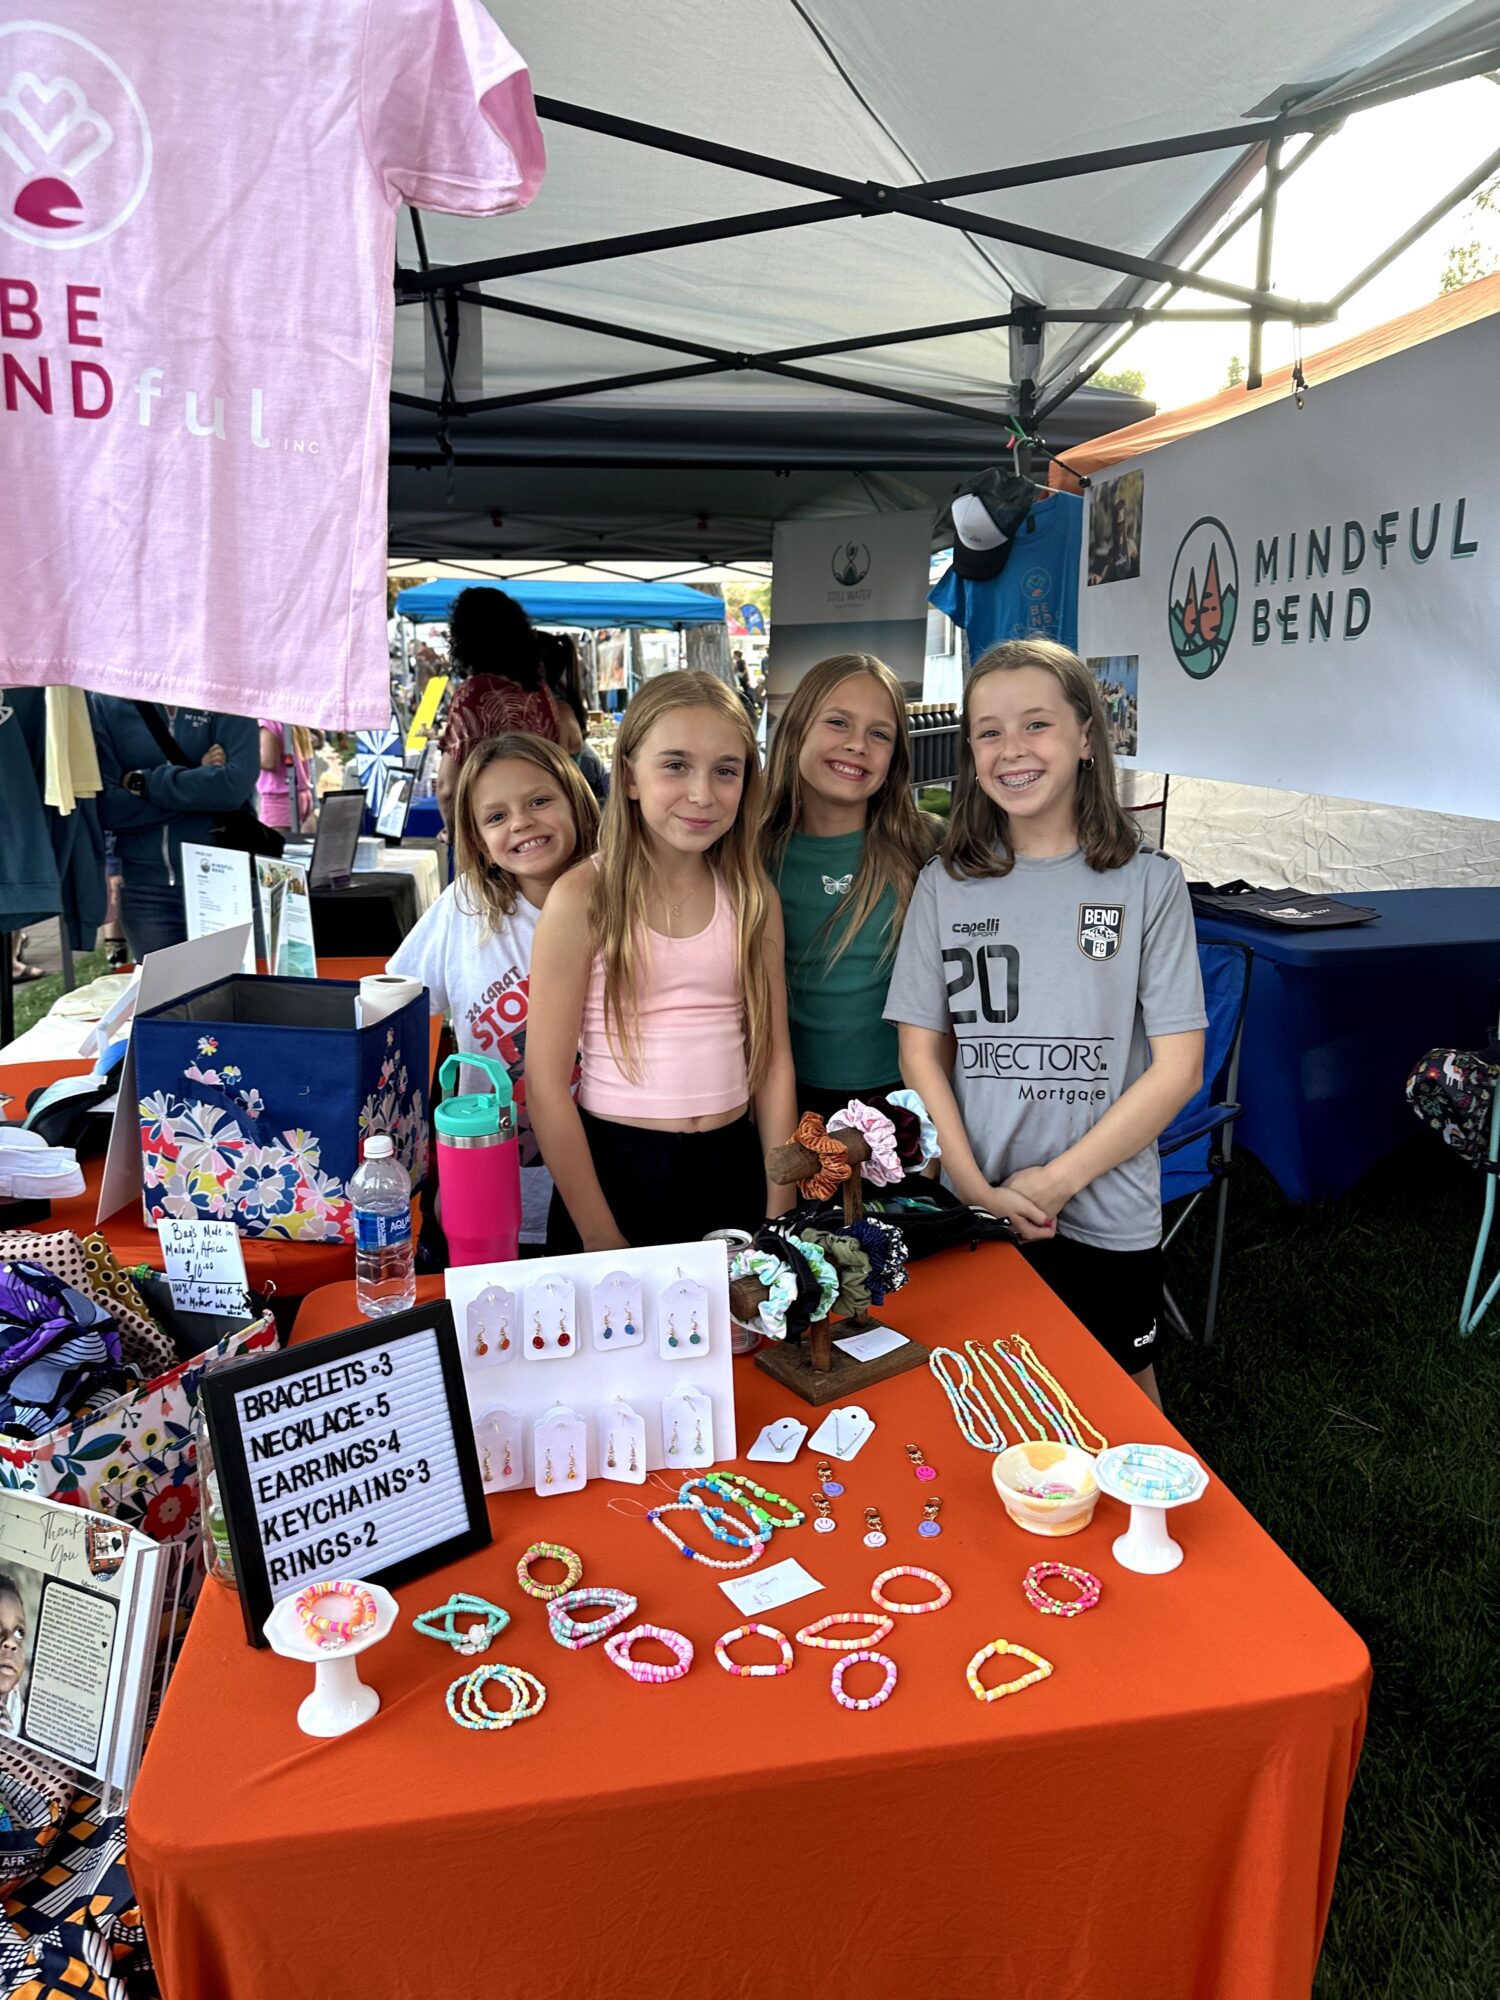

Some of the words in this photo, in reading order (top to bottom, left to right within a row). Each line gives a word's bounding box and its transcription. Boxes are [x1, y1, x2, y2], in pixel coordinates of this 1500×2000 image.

[0, 277, 103, 348] BE
[284, 441, 319, 455] INC
[1254, 498, 1478, 586] MINDFUL
[1251, 587, 1371, 645] BEND
[952, 918, 1000, 937] capelli
[1084, 908, 1119, 926] BEND
[1094, 942, 1104, 953] FC
[481, 965, 522, 1005] CARAT
[941, 944, 1020, 1024] 20
[960, 1043, 1103, 1075] DIRECTORS
[204, 1225, 222, 1238] Made
[225, 1225, 233, 1237] in
[244, 1360, 367, 1422] BRACELETS
[251, 1402, 364, 1462] NECKLACE
[258, 1438, 379, 1503] EARRINGS
[40, 1510, 84, 1549] Thank
[263, 1470, 407, 1545] KEYCHAINS
[269, 1532, 351, 1585] RINGS
